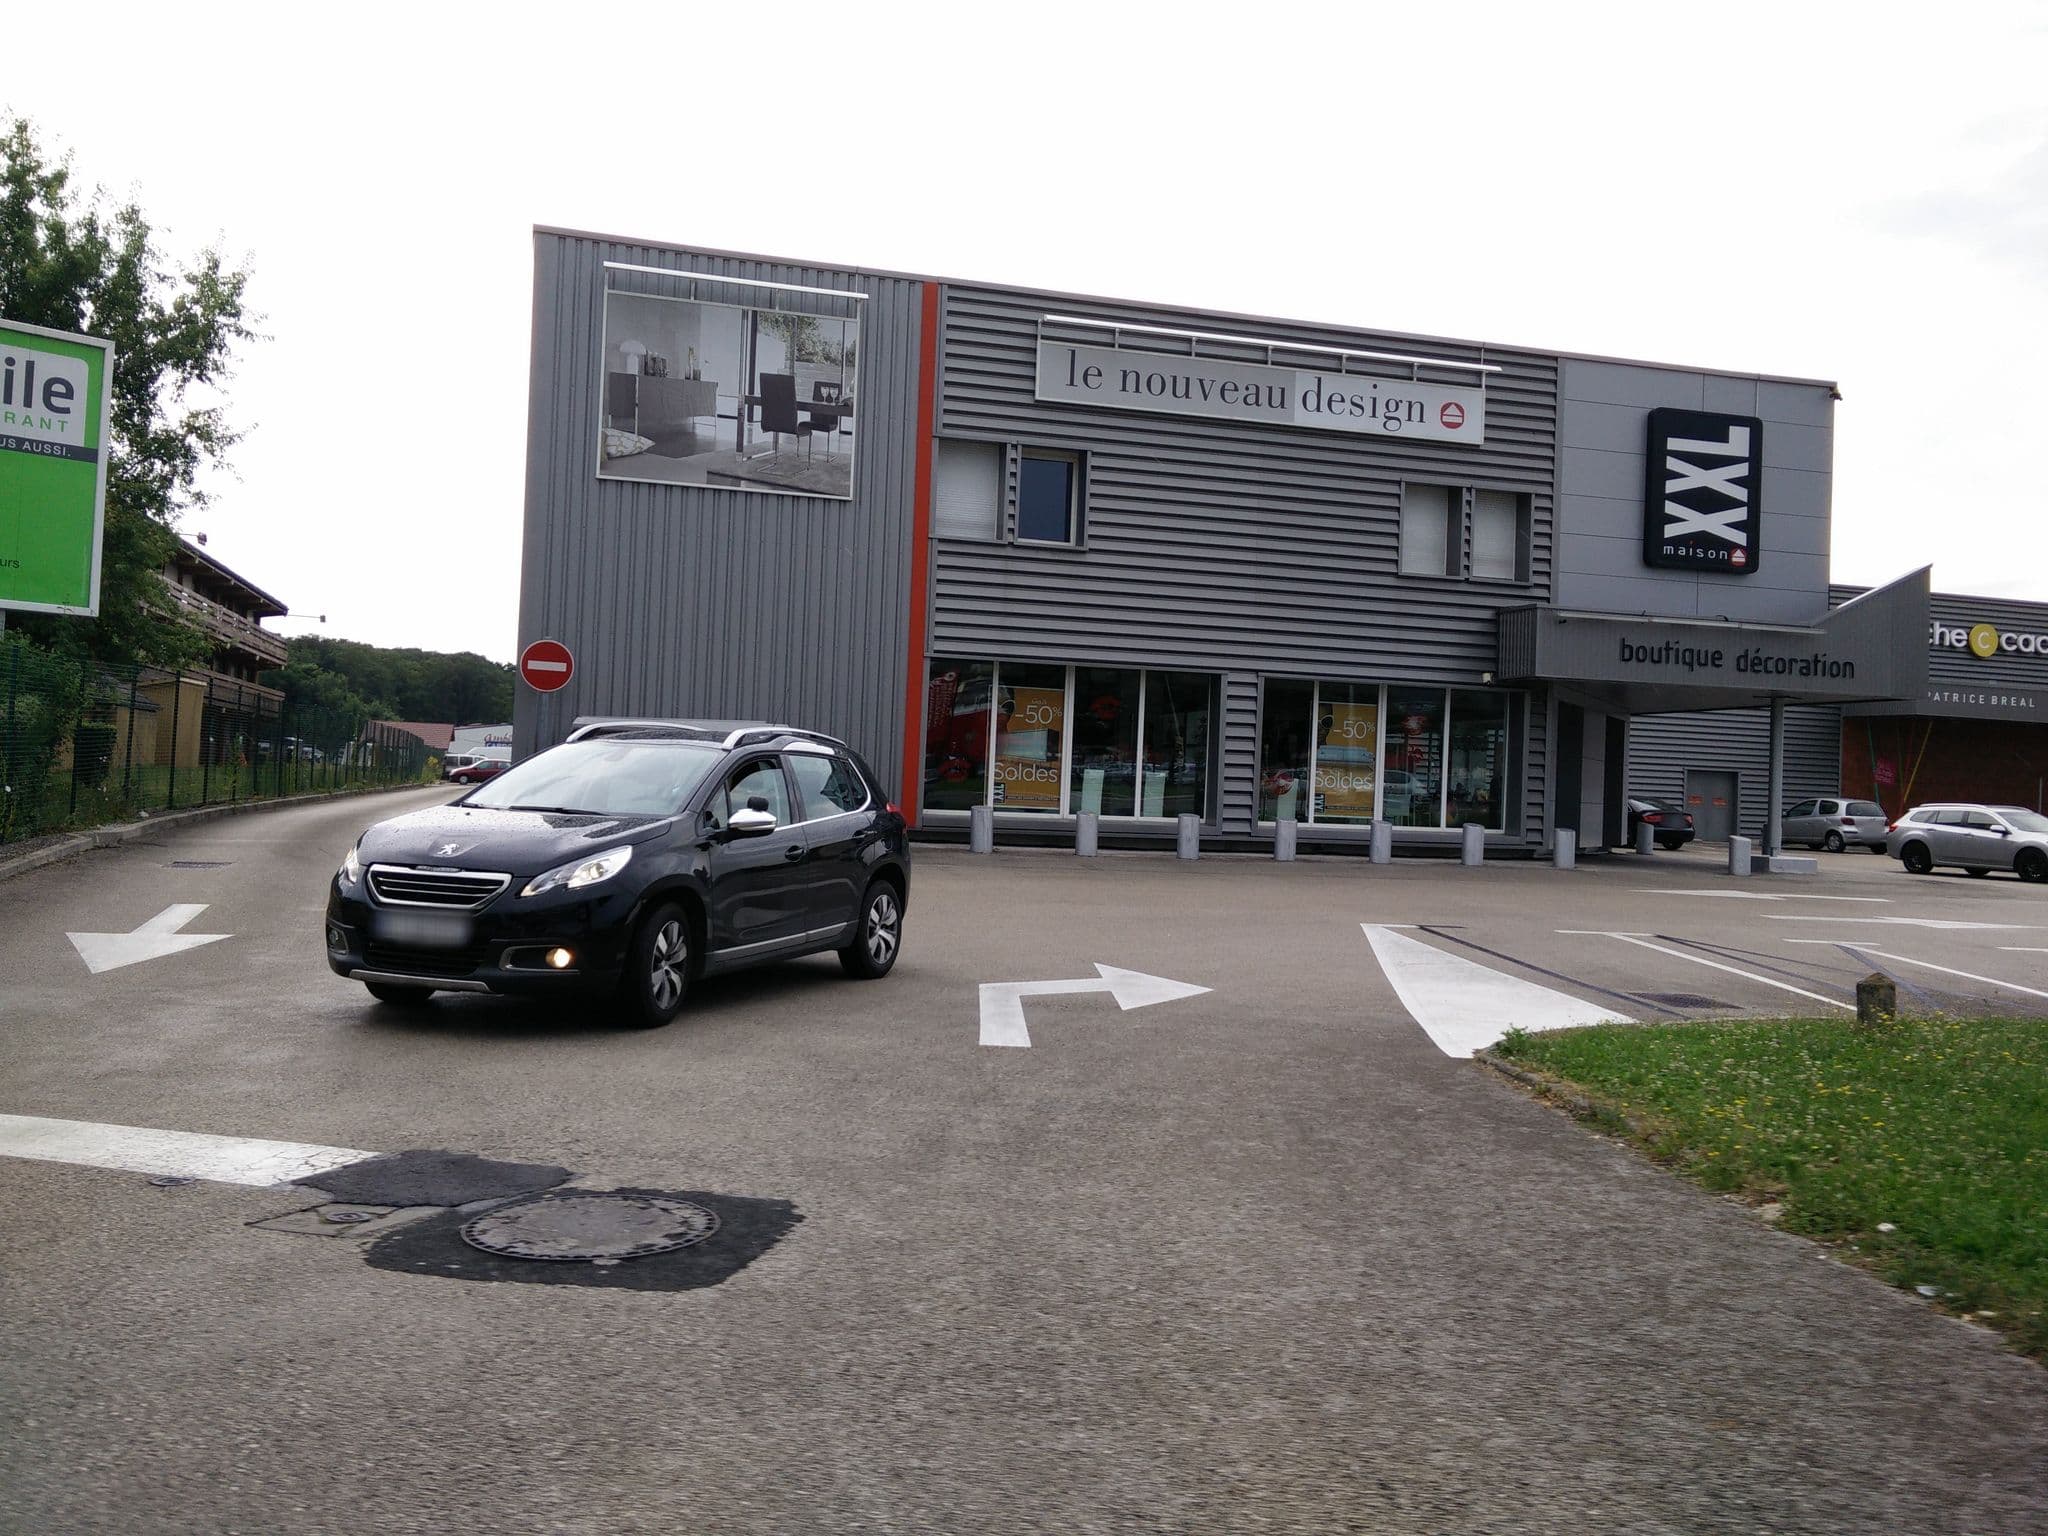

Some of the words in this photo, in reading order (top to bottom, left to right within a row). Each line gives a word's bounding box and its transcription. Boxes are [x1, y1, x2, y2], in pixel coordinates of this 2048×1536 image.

[1065, 349, 1104, 390] le
[1118, 367, 1288, 410] nouveau
[1302, 376, 1427, 431] design
[22, 441, 72, 457] AUSSI.
[1664, 425, 1751, 547] XXL
[1663, 540, 1728, 560] maison
[1929, 621, 1968, 648] he
[1620, 638, 1724, 671] boutique
[1736, 647, 1855, 679] décoration
[1991, 696, 2036, 708] BREAL
[993, 763, 1058, 783] Soldes
